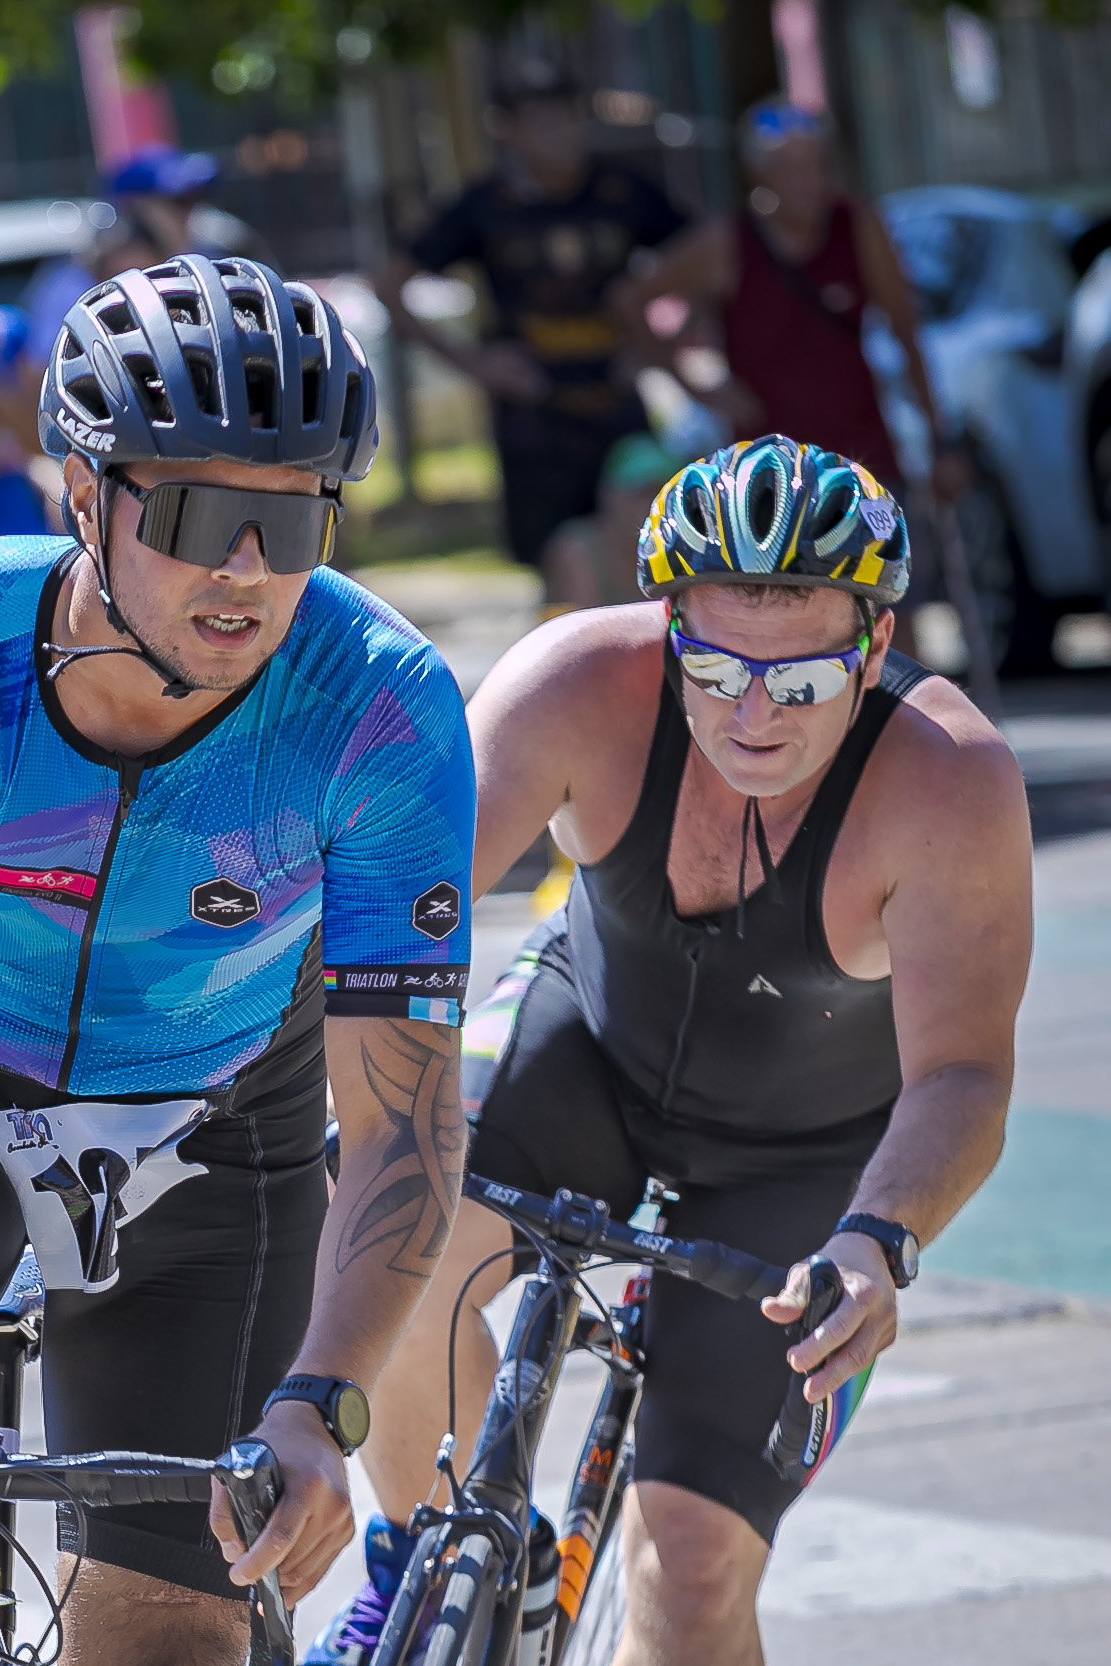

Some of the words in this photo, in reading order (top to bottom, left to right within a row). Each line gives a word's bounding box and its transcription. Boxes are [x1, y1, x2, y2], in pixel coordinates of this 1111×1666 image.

[57, 407, 116, 452] LAZER
[867, 509, 892, 530] 099
[345, 972, 398, 988] TRIATLON
